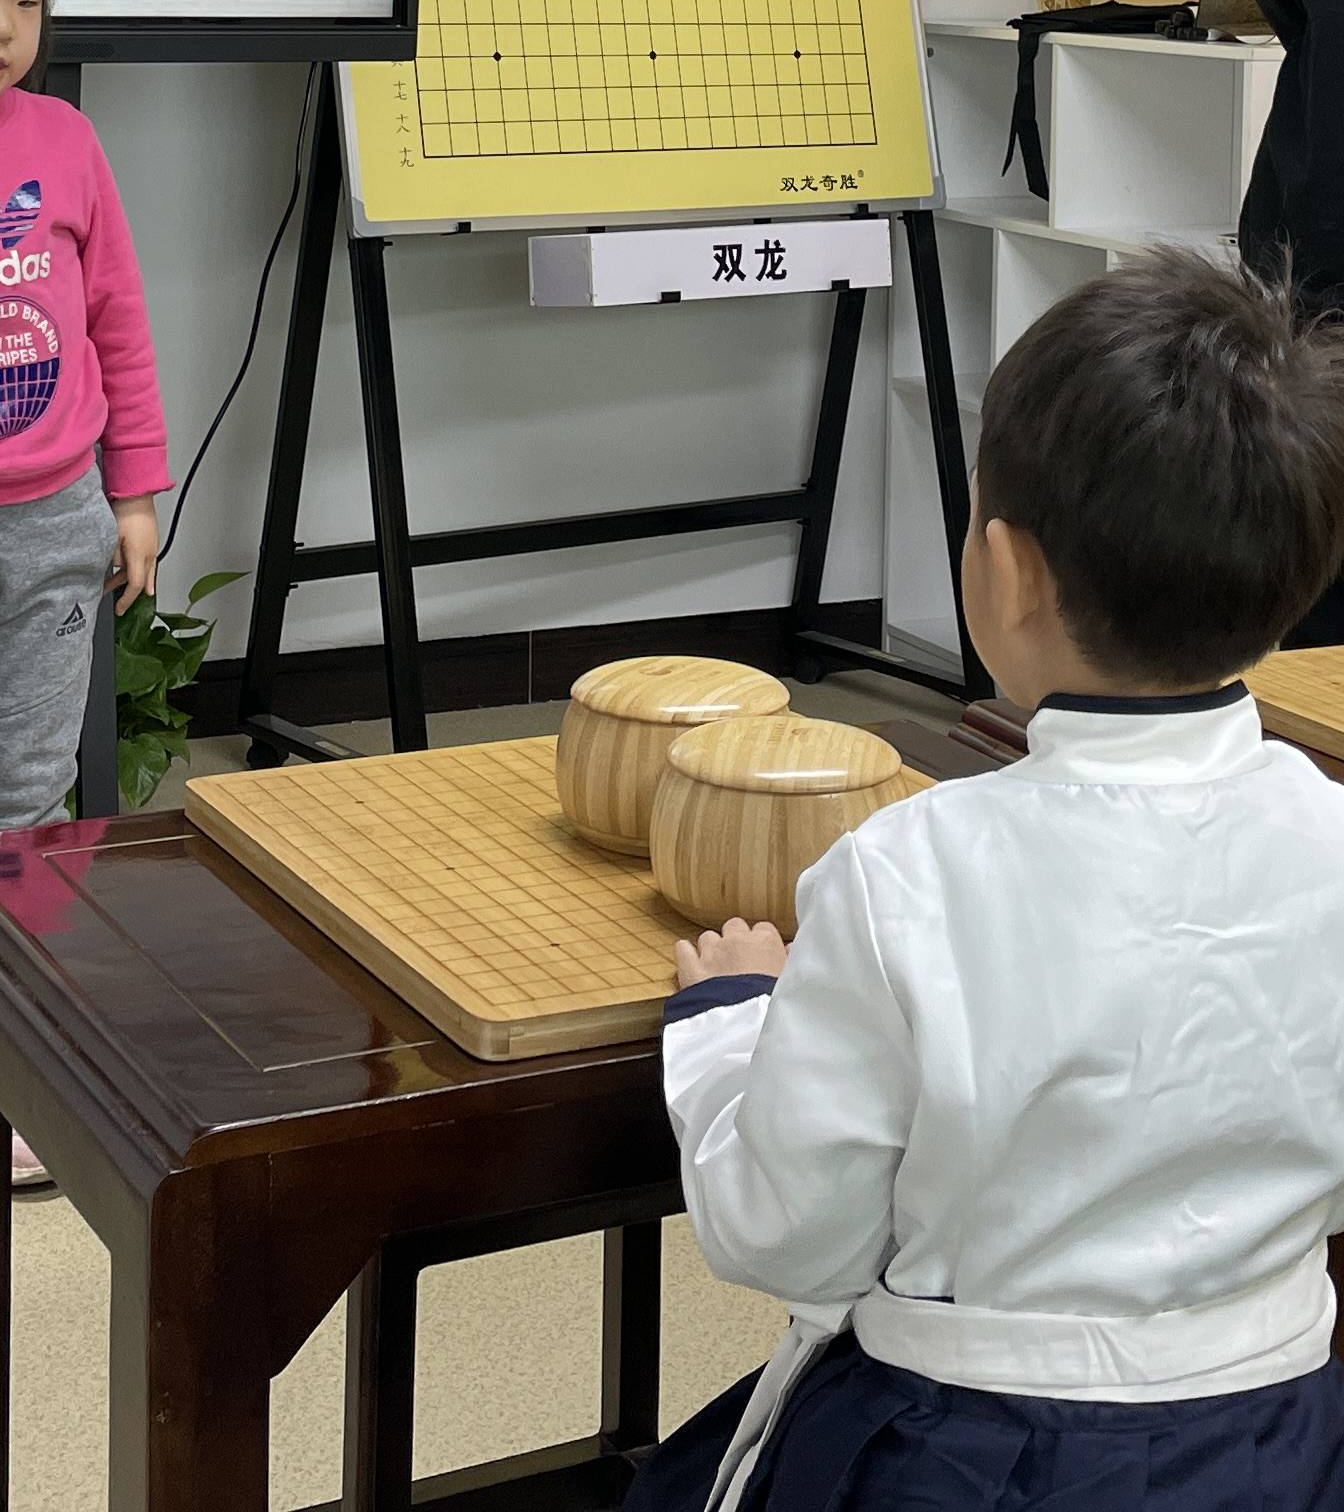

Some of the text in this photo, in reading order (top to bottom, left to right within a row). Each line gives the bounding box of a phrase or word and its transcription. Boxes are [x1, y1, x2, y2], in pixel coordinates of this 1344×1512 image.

[393, 80, 408, 100] 十七
[395, 113, 410, 134] 十八
[399, 146, 415, 167] 十九
[780, 174, 859, 192] 双龙奇胜
[712, 239, 787, 282] 双龙
[5, 332, 33, 348] THE
[22, 305, 59, 354] BRAND
